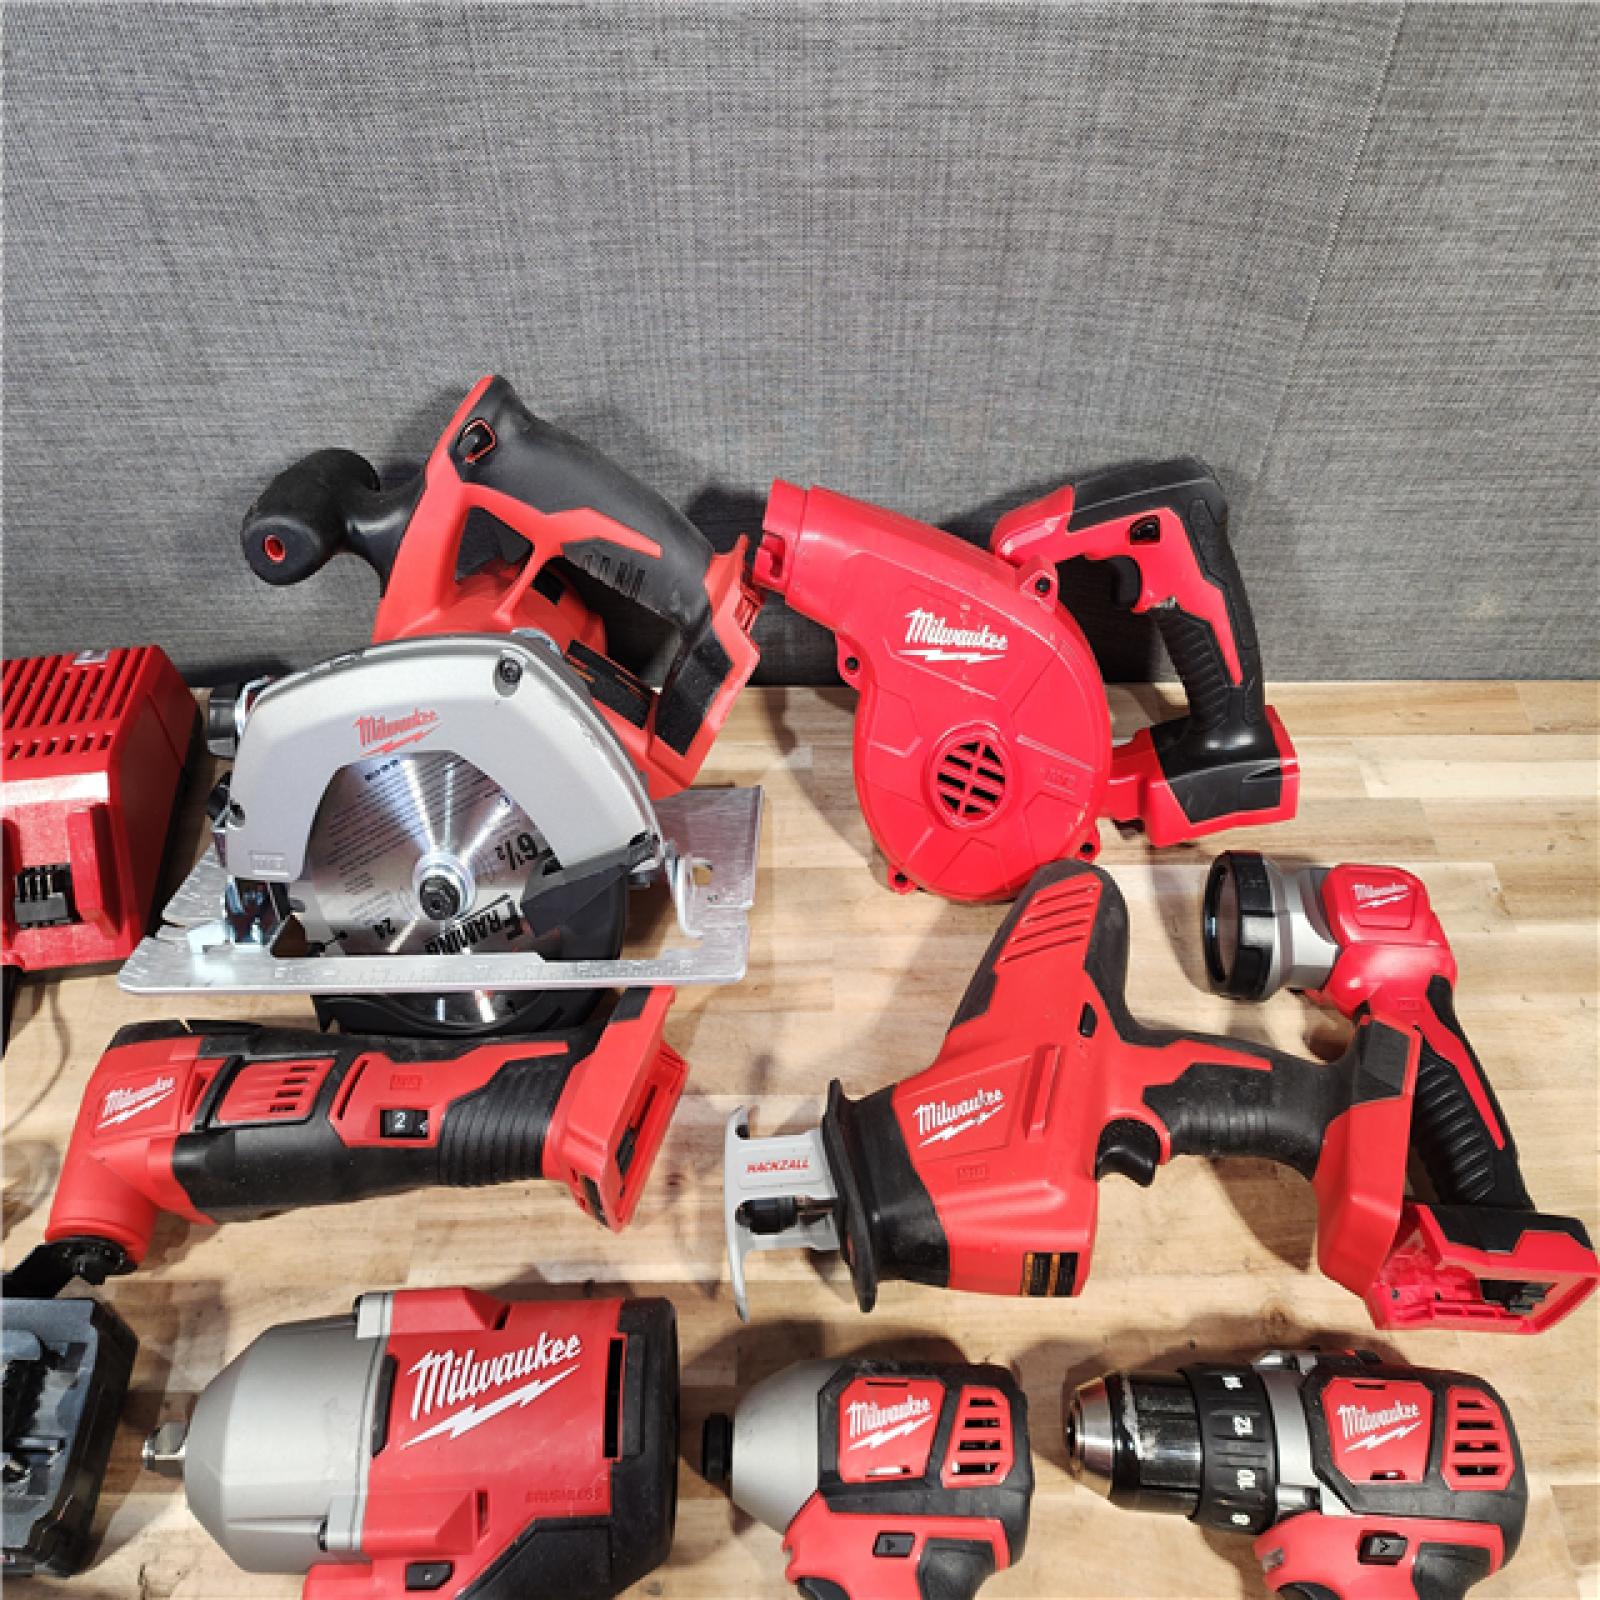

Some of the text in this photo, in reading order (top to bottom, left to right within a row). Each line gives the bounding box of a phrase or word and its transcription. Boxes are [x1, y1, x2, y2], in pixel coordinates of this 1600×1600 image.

[904, 607, 1008, 650] Milwaukee
[352, 707, 438, 747] Milwaukee
[102, 1077, 175, 1119] Milwaukee
[914, 1089, 1004, 1135] Milwaukee
[395, 1111, 406, 1129] 2
[406, 1331, 583, 1421] Milwaukee
[845, 1395, 931, 1438] Milwaukee
[1337, 1400, 1421, 1439] Milwaukee
